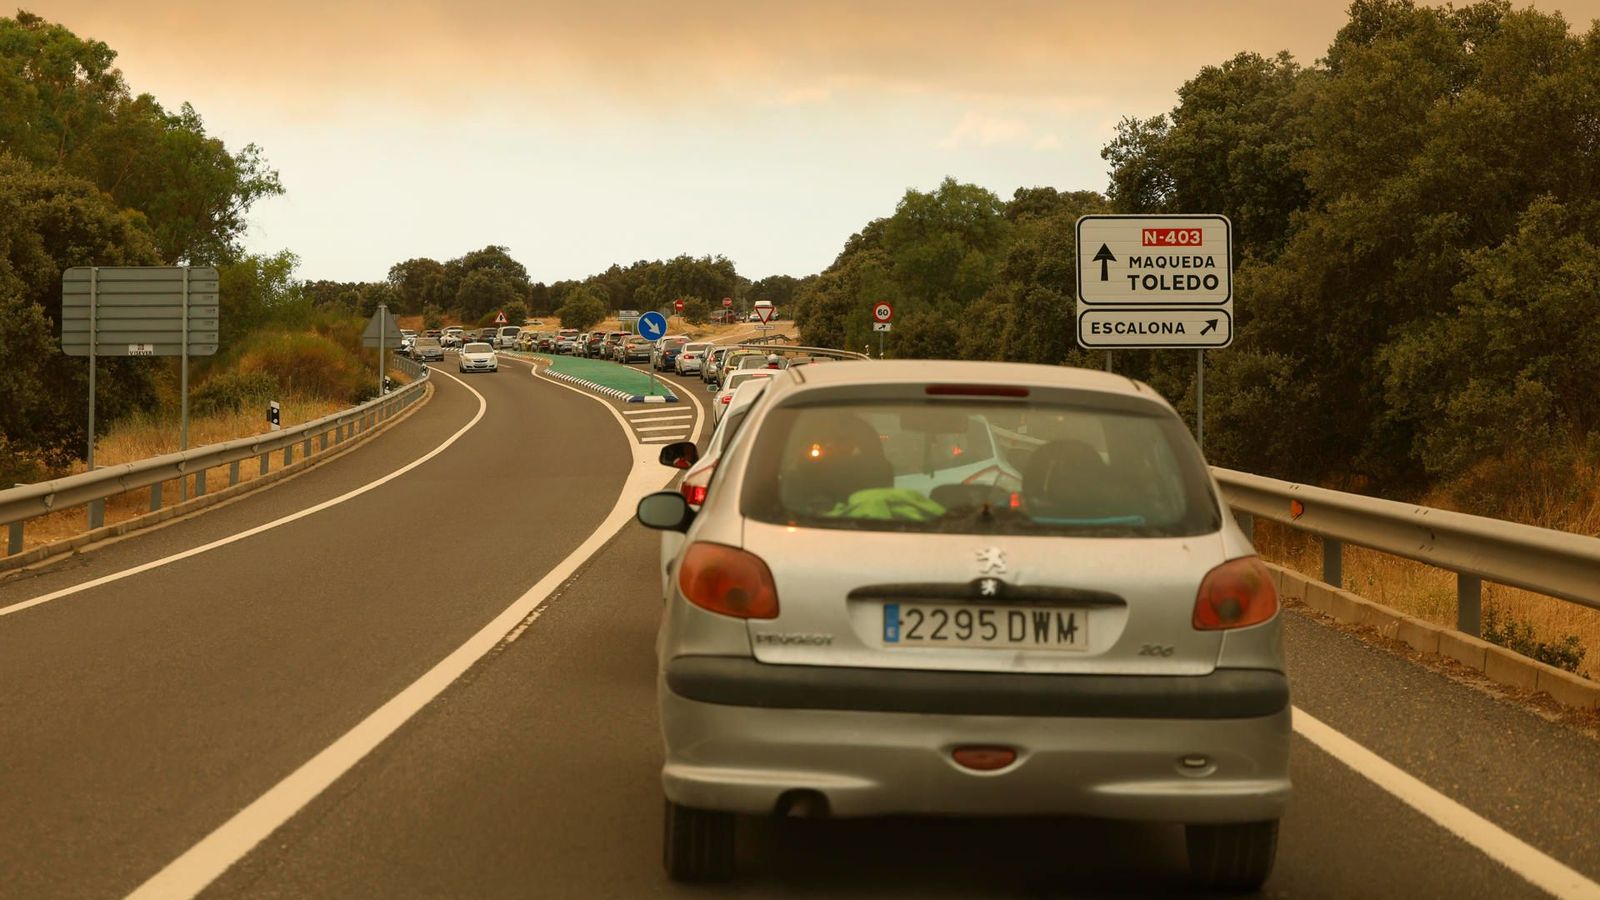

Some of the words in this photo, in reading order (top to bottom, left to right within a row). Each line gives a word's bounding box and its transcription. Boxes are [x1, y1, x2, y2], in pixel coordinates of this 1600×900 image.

[1144, 230, 1201, 244] N-403
[1129, 256, 1216, 269] MAQUEDA
[1127, 274, 1219, 291] TOLEDO
[877, 308, 889, 317] 60
[1091, 321, 1186, 335] ESCALONA
[905, 608, 998, 641] 2295
[1008, 610, 1077, 645] DWM
[1137, 643, 1175, 658] 206
